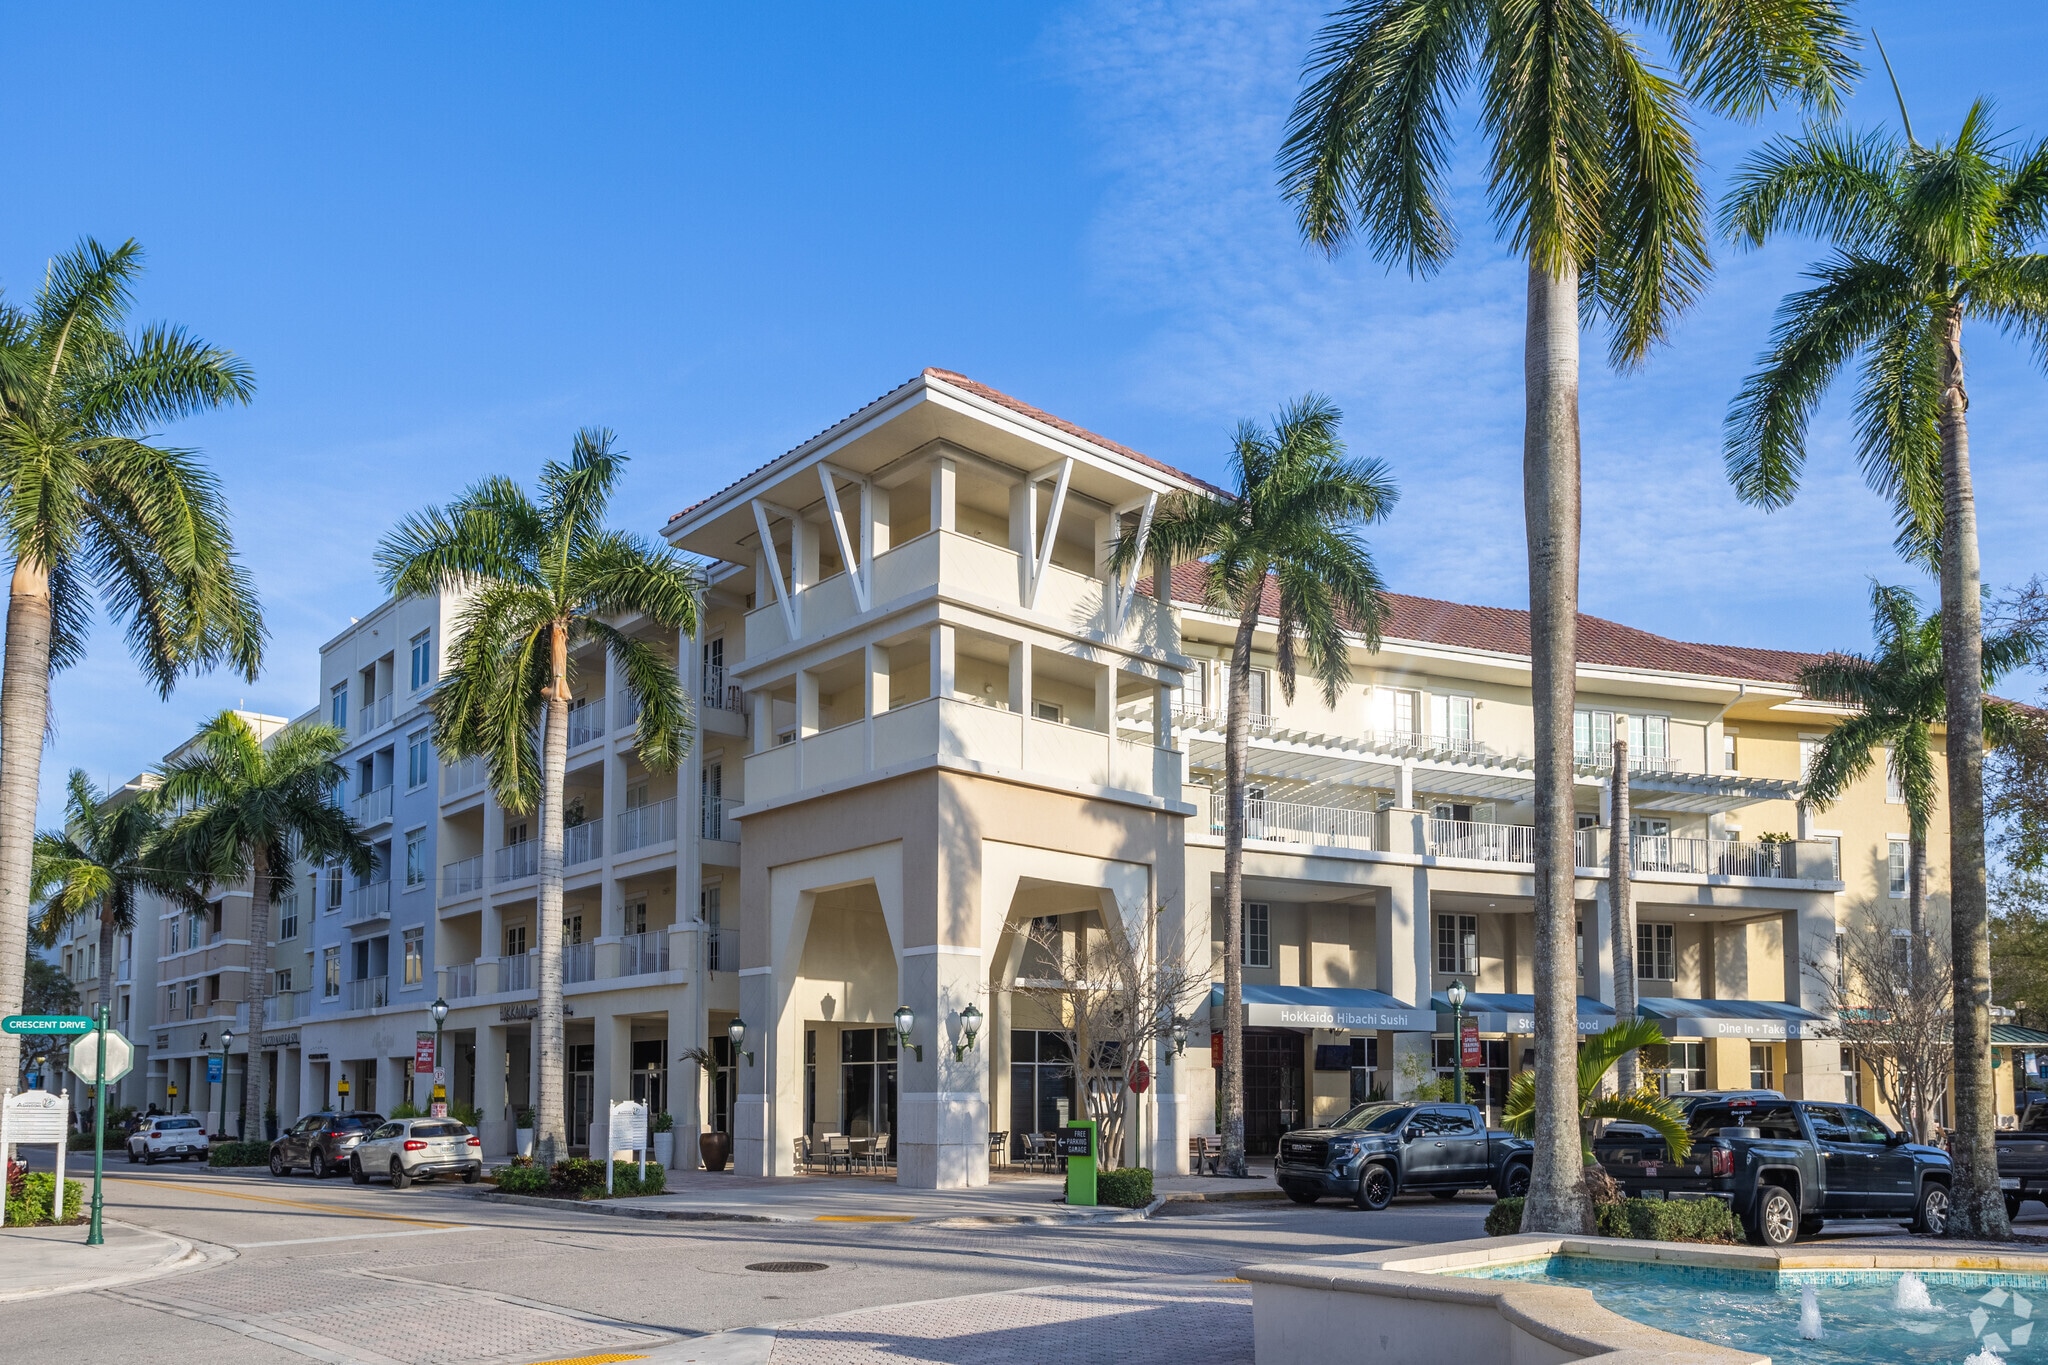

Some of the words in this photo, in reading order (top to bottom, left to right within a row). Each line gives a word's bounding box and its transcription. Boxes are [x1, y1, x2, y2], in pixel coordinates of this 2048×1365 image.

[1281, 1010, 1334, 1023] Hokkaido
[1337, 1012, 1377, 1025] Hibachi
[1380, 1014, 1408, 1026] Sushi
[1519, 1018, 1535, 1029] Ste
[9, 1020, 58, 1029] CRESCENT
[59, 1020, 87, 1029] DRIVE
[1718, 1023, 1742, 1034] Dine
[1744, 1024, 1754, 1034] In
[1762, 1024, 1786, 1034] Take
[1788, 1024, 1807, 1035] Out
[1637, 1160, 1664, 1168] GMC
